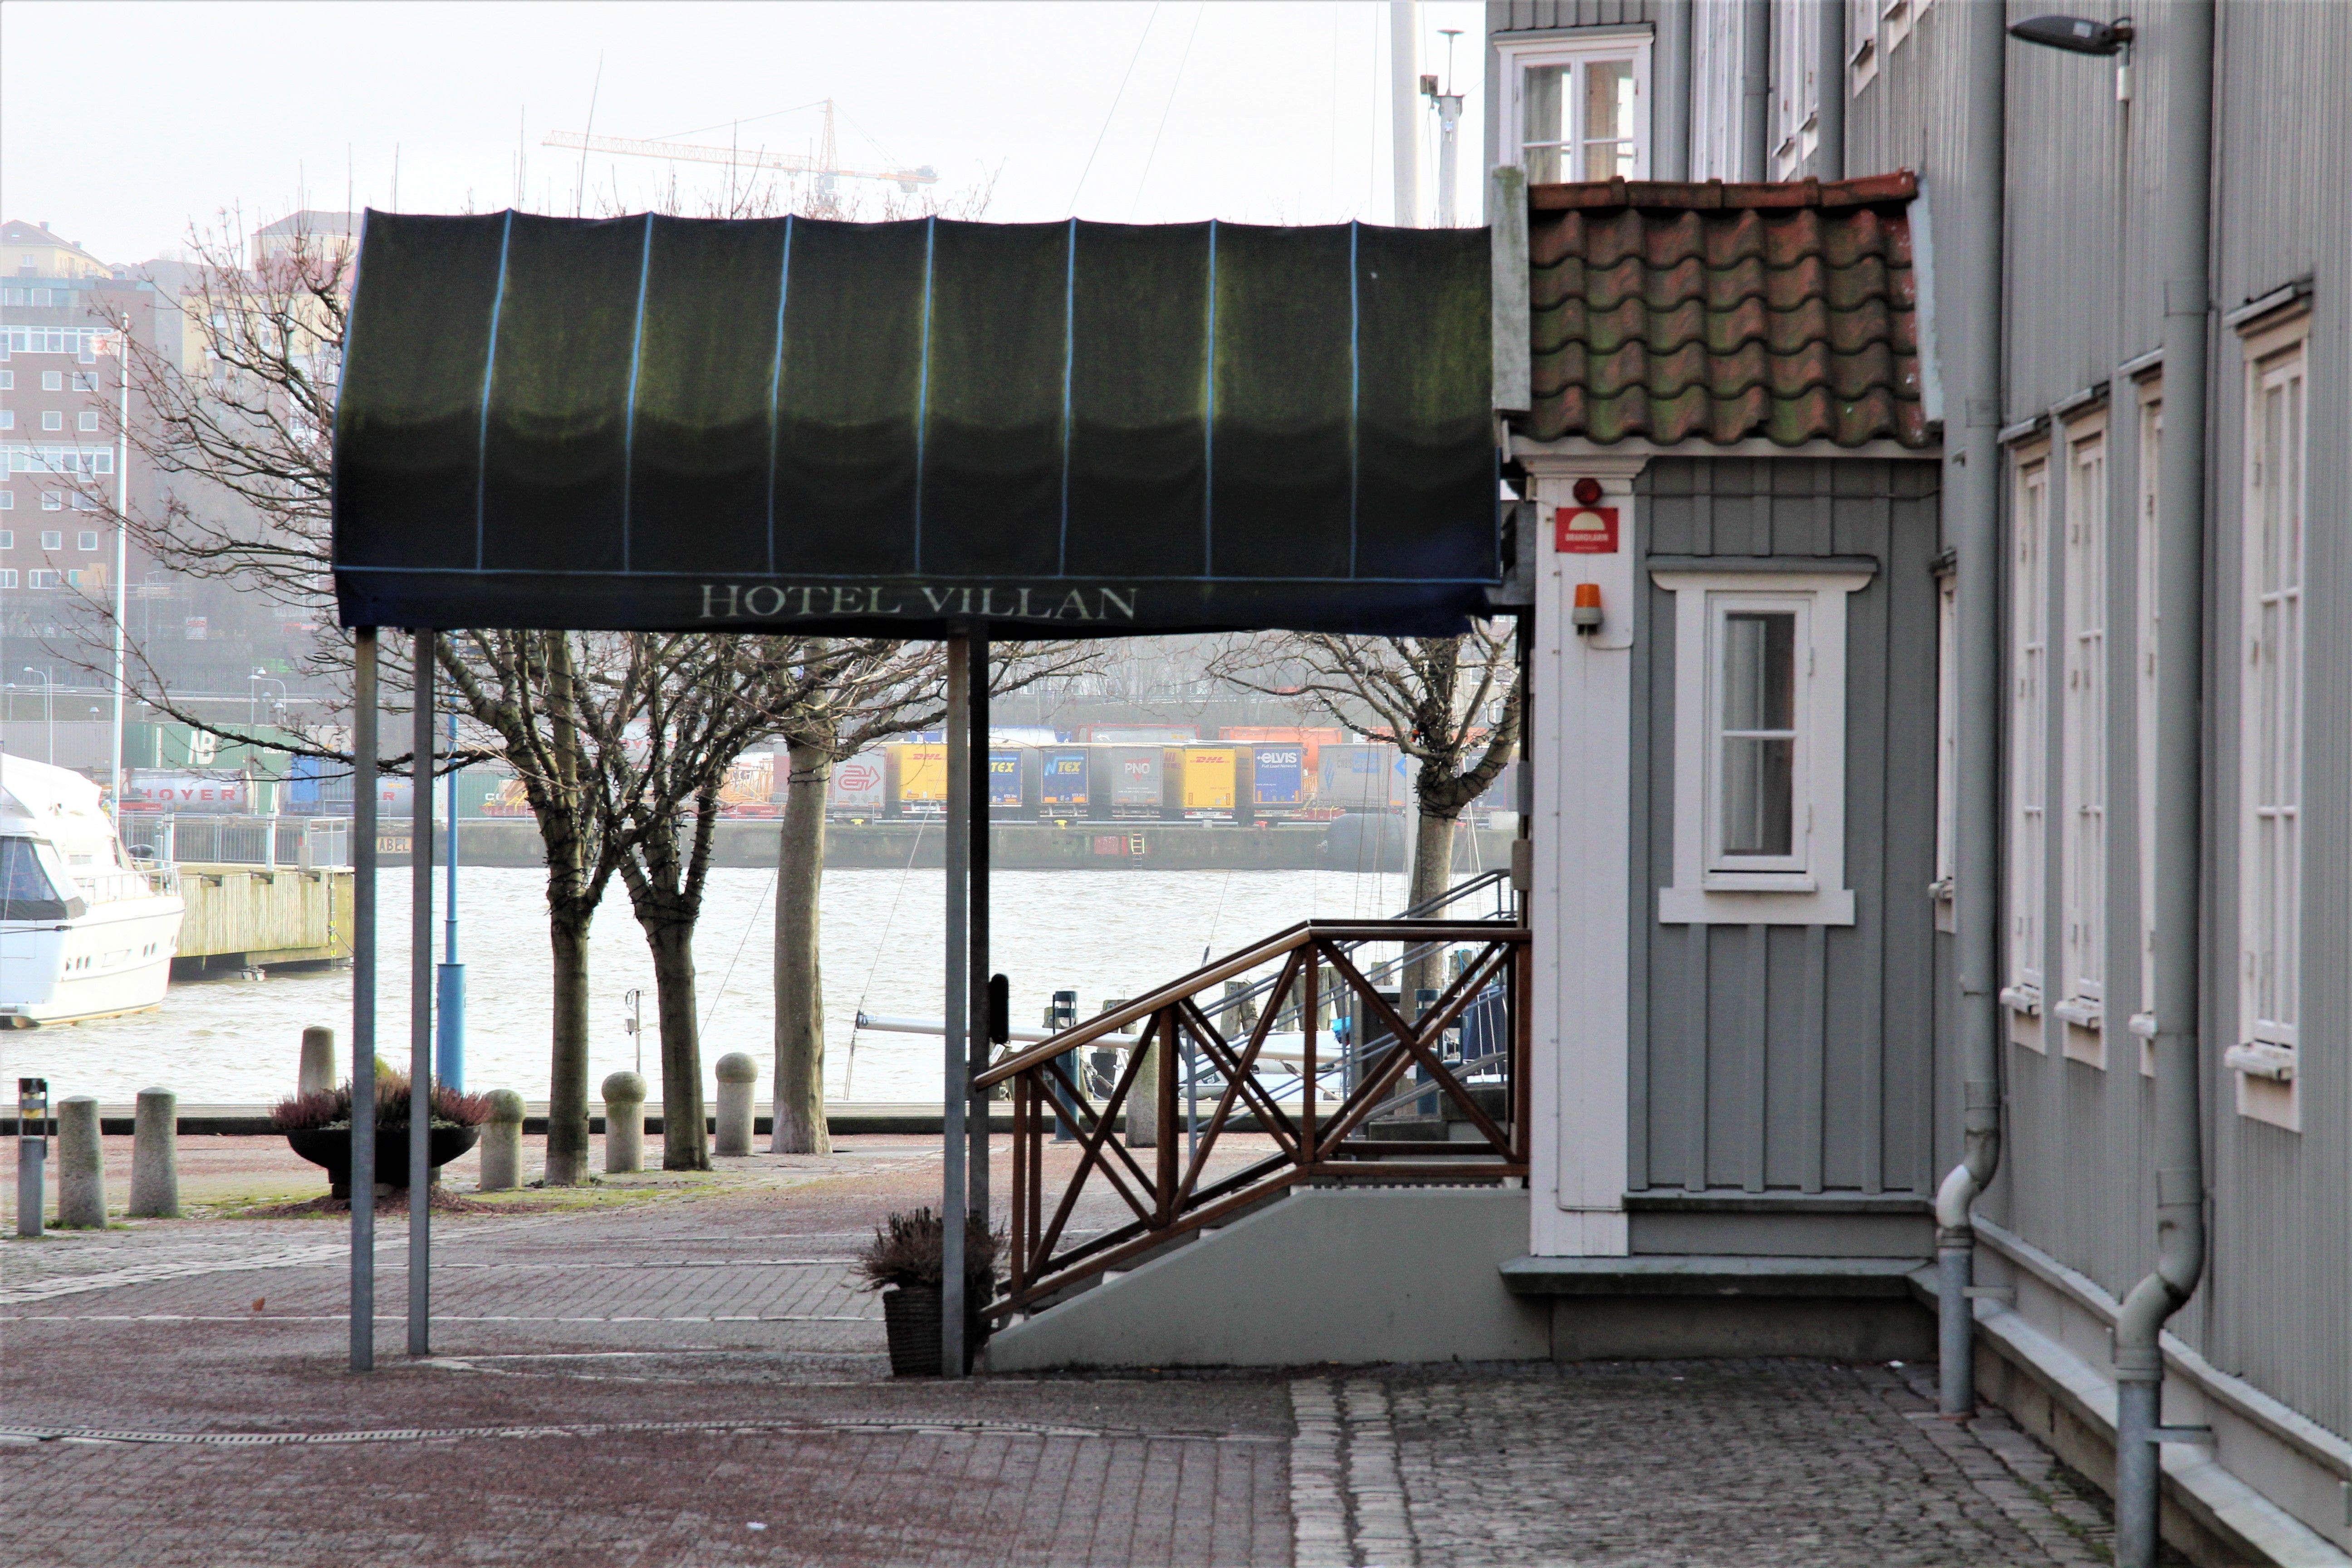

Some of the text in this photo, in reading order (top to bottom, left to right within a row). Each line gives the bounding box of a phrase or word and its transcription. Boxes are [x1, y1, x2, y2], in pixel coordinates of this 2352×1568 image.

[699, 584, 1137, 620] HOTEL VILLAN
[991, 762, 1015, 772] TEX
[1125, 763, 1150, 774] PNO
[379, 838, 409, 851] ABEL
